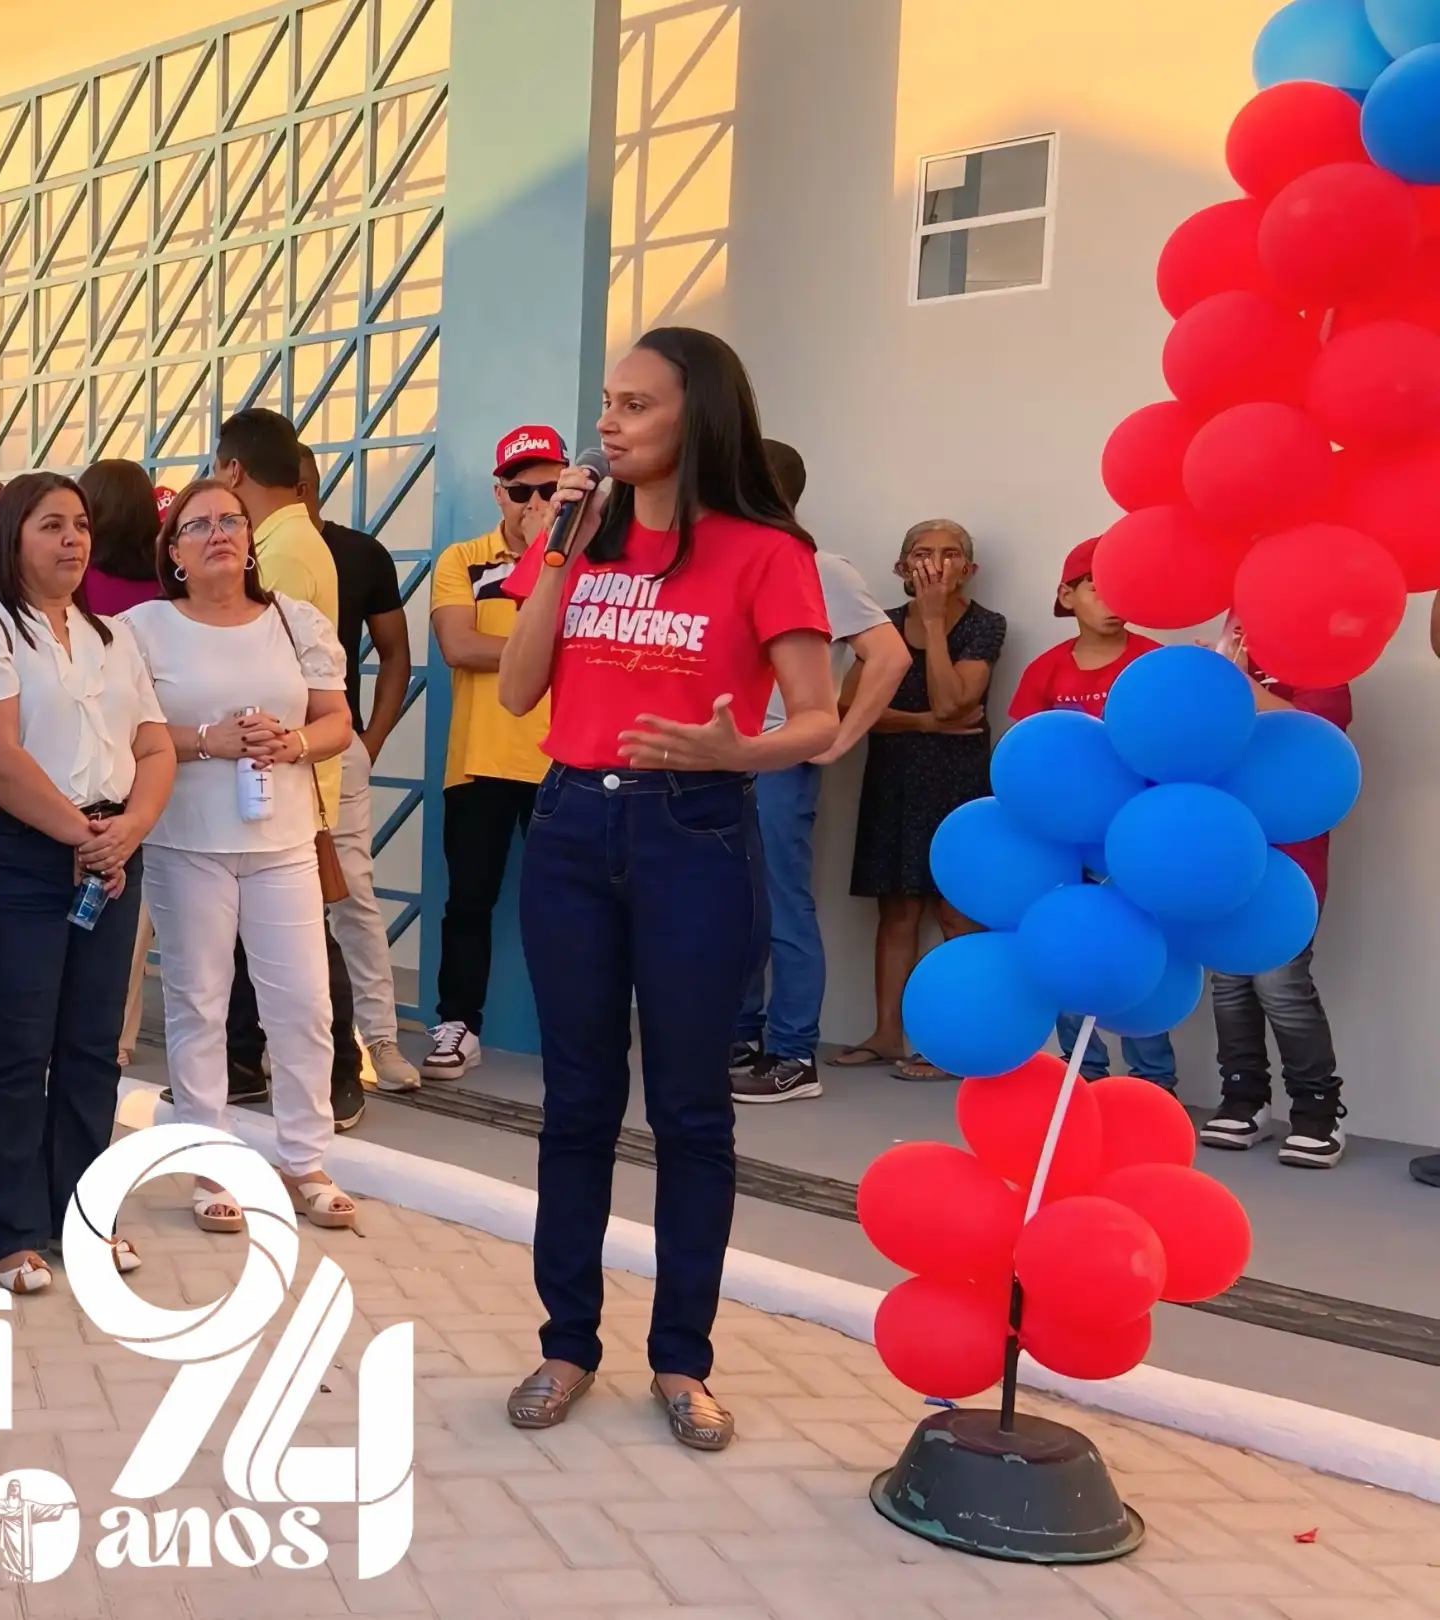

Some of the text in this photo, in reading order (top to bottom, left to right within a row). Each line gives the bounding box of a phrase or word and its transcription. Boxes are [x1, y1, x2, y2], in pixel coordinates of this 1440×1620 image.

[504, 439, 550, 460] LUCIANA
[570, 572, 665, 608] BURITI
[563, 605, 709, 651] BRAVENSE
